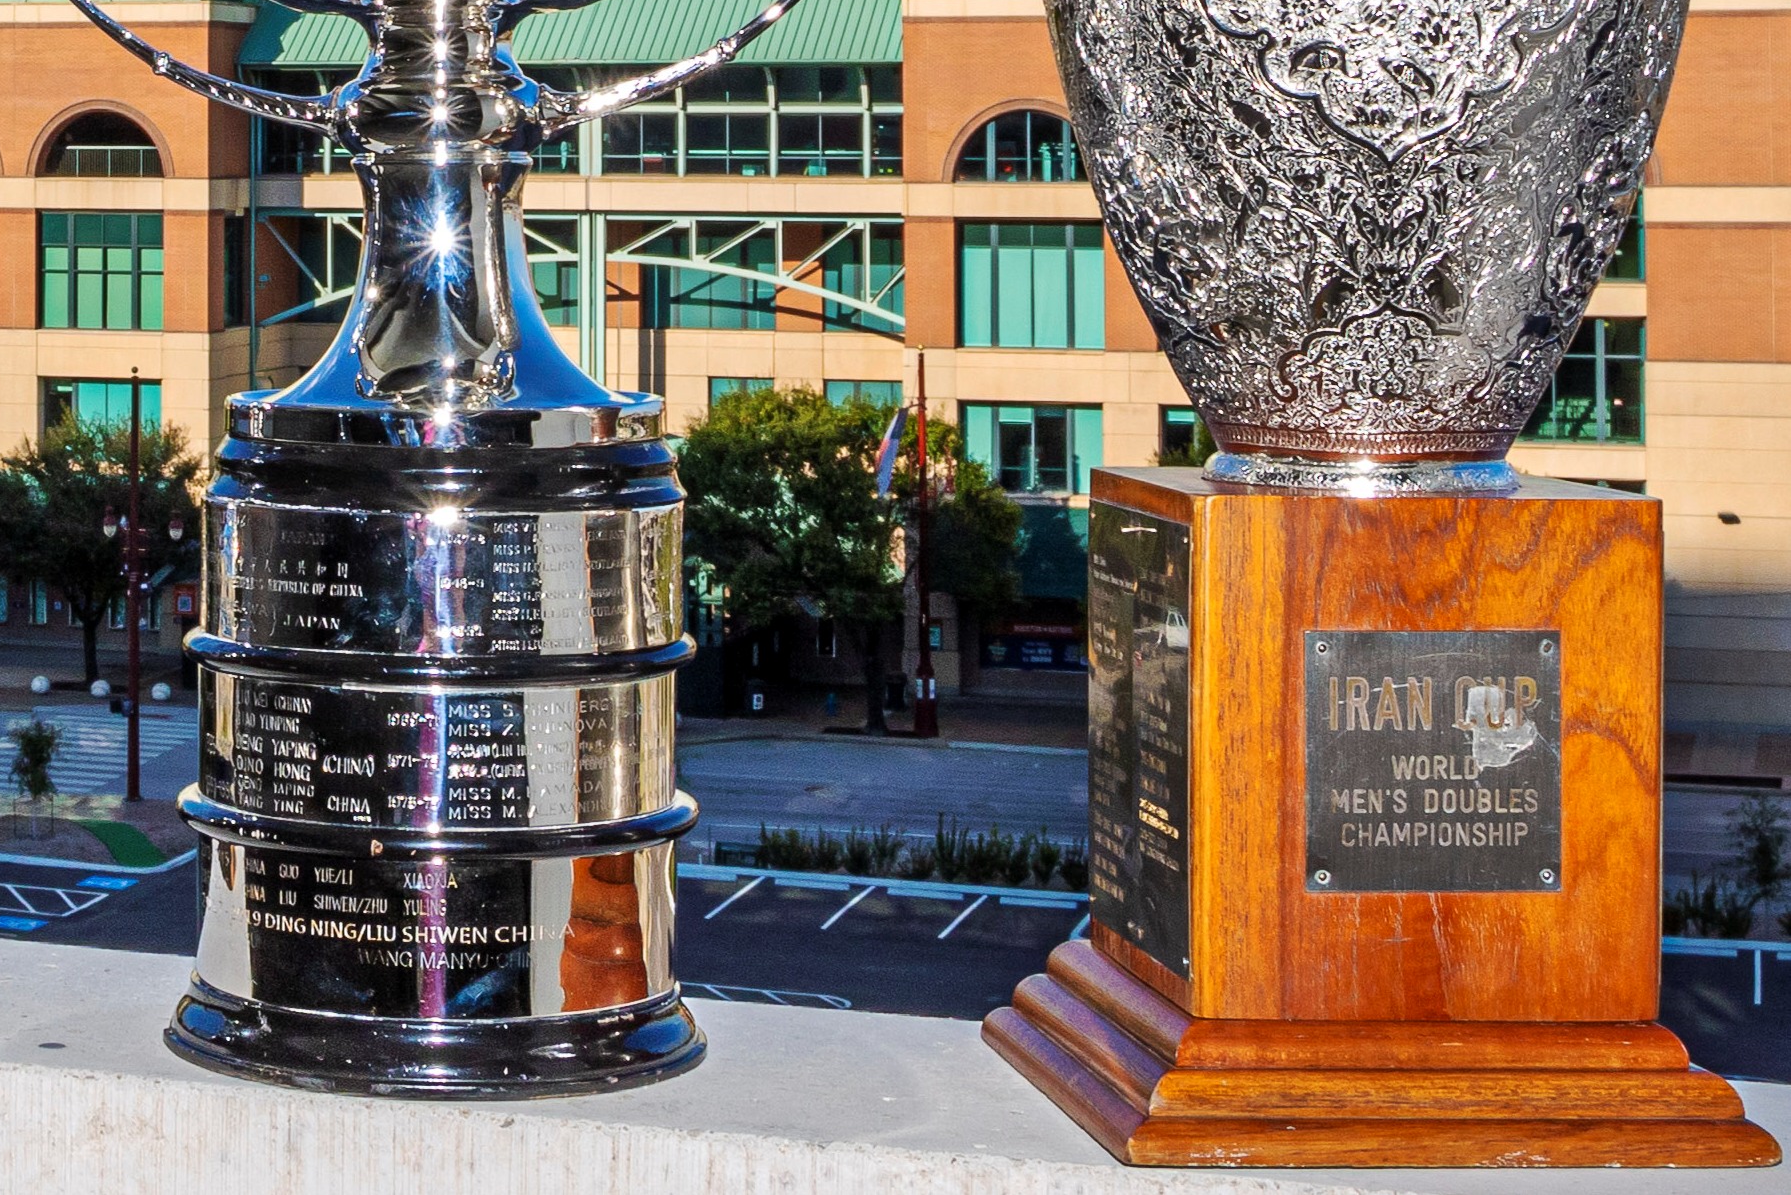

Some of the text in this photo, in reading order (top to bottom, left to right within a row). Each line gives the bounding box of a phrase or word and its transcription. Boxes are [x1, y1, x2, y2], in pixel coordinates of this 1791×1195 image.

[492, 544, 521, 556] MISS
[492, 562, 521, 574] MISS
[492, 590, 521, 603] MISS
[282, 613, 341, 631] JAPAN
[273, 694, 312, 715] (CHINA)
[447, 704, 492, 719] MISS
[1328, 675, 1538, 732] IRAN CUP
[447, 723, 492, 737] MISS
[235, 732, 264, 754] DENG
[271, 738, 318, 761] YAPING
[273, 761, 312, 782] HONG
[322, 754, 376, 778] (CHINA)
[1390, 754, 1480, 781] WORLD
[273, 782, 316, 798] YAPING
[447, 787, 492, 801] MISS
[273, 794, 372, 815] YING CHINA
[1330, 788, 1540, 815] MEN'S DOUBLES
[447, 804, 492, 821] MISS
[1340, 821, 1529, 848] CHAMPIONSHIP
[244, 857, 266, 876] HINA
[278, 863, 300, 879] GUO
[313, 866, 354, 886] YUE/LI
[244, 884, 448, 917] HINA LIU SHIWEN/ZHU YULING
[264, 912, 307, 934] DING
[310, 919, 398, 942] NING/LIU
[401, 924, 488, 945] SHIWEN
[494, 922, 576, 944] CHINA
[357, 948, 414, 969] WANG
